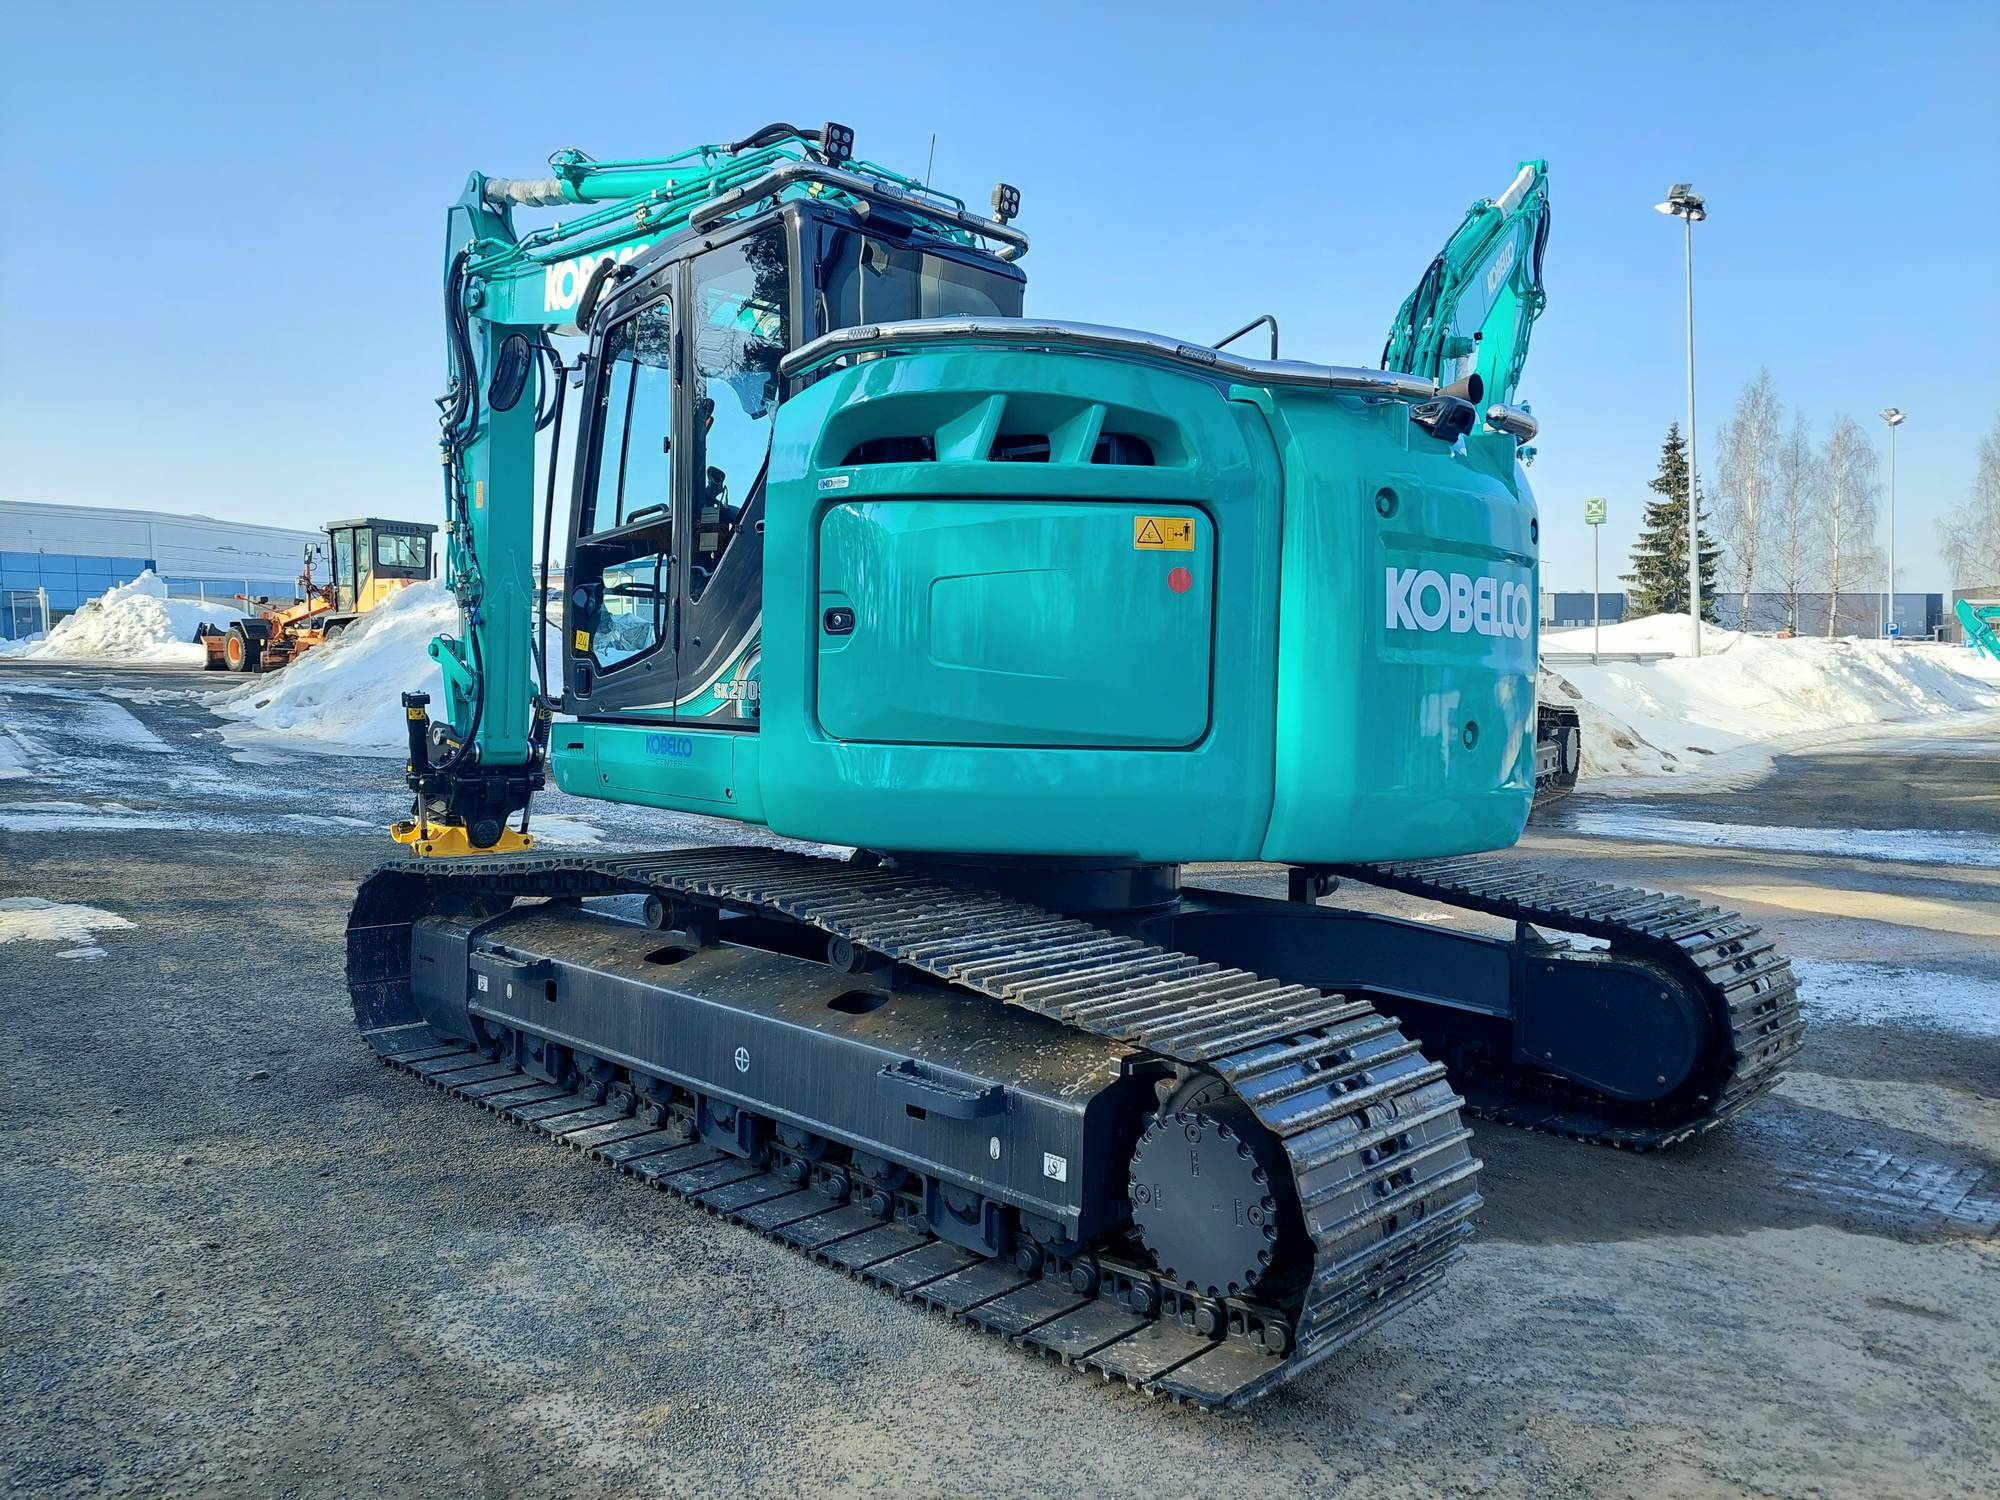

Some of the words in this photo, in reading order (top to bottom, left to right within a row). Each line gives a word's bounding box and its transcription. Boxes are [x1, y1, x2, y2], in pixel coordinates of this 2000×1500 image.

[1386, 567, 1532, 641] KOBELCO
[714, 680, 760, 700] SK270
[646, 734, 693, 758] KOBELCO
